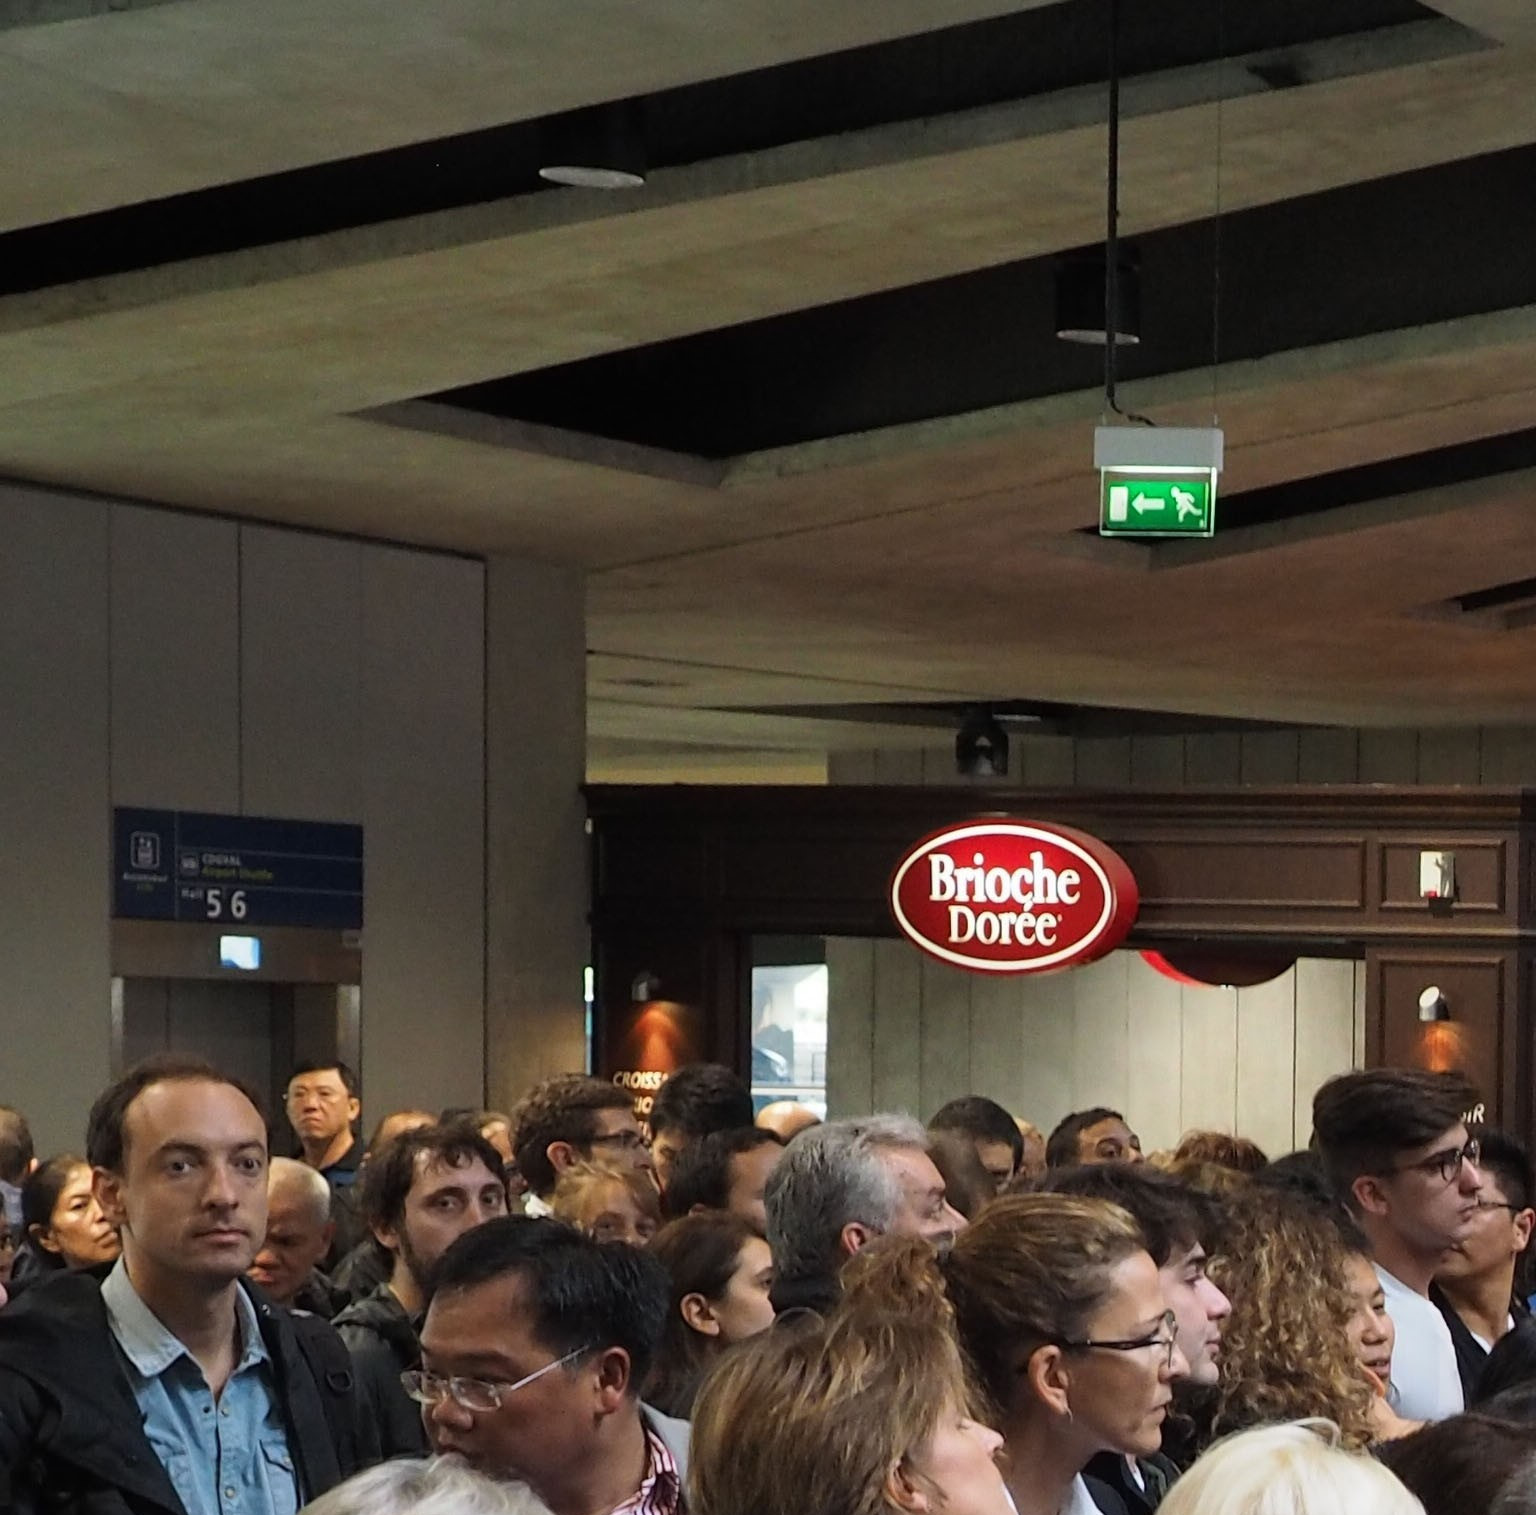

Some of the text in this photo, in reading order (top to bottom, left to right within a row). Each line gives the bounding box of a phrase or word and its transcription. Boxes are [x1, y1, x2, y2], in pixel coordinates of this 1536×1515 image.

[928, 851, 1081, 905] Brioche
[206, 889, 222, 919] 5
[231, 891, 247, 920] 6
[948, 900, 1057, 947] Dorée
